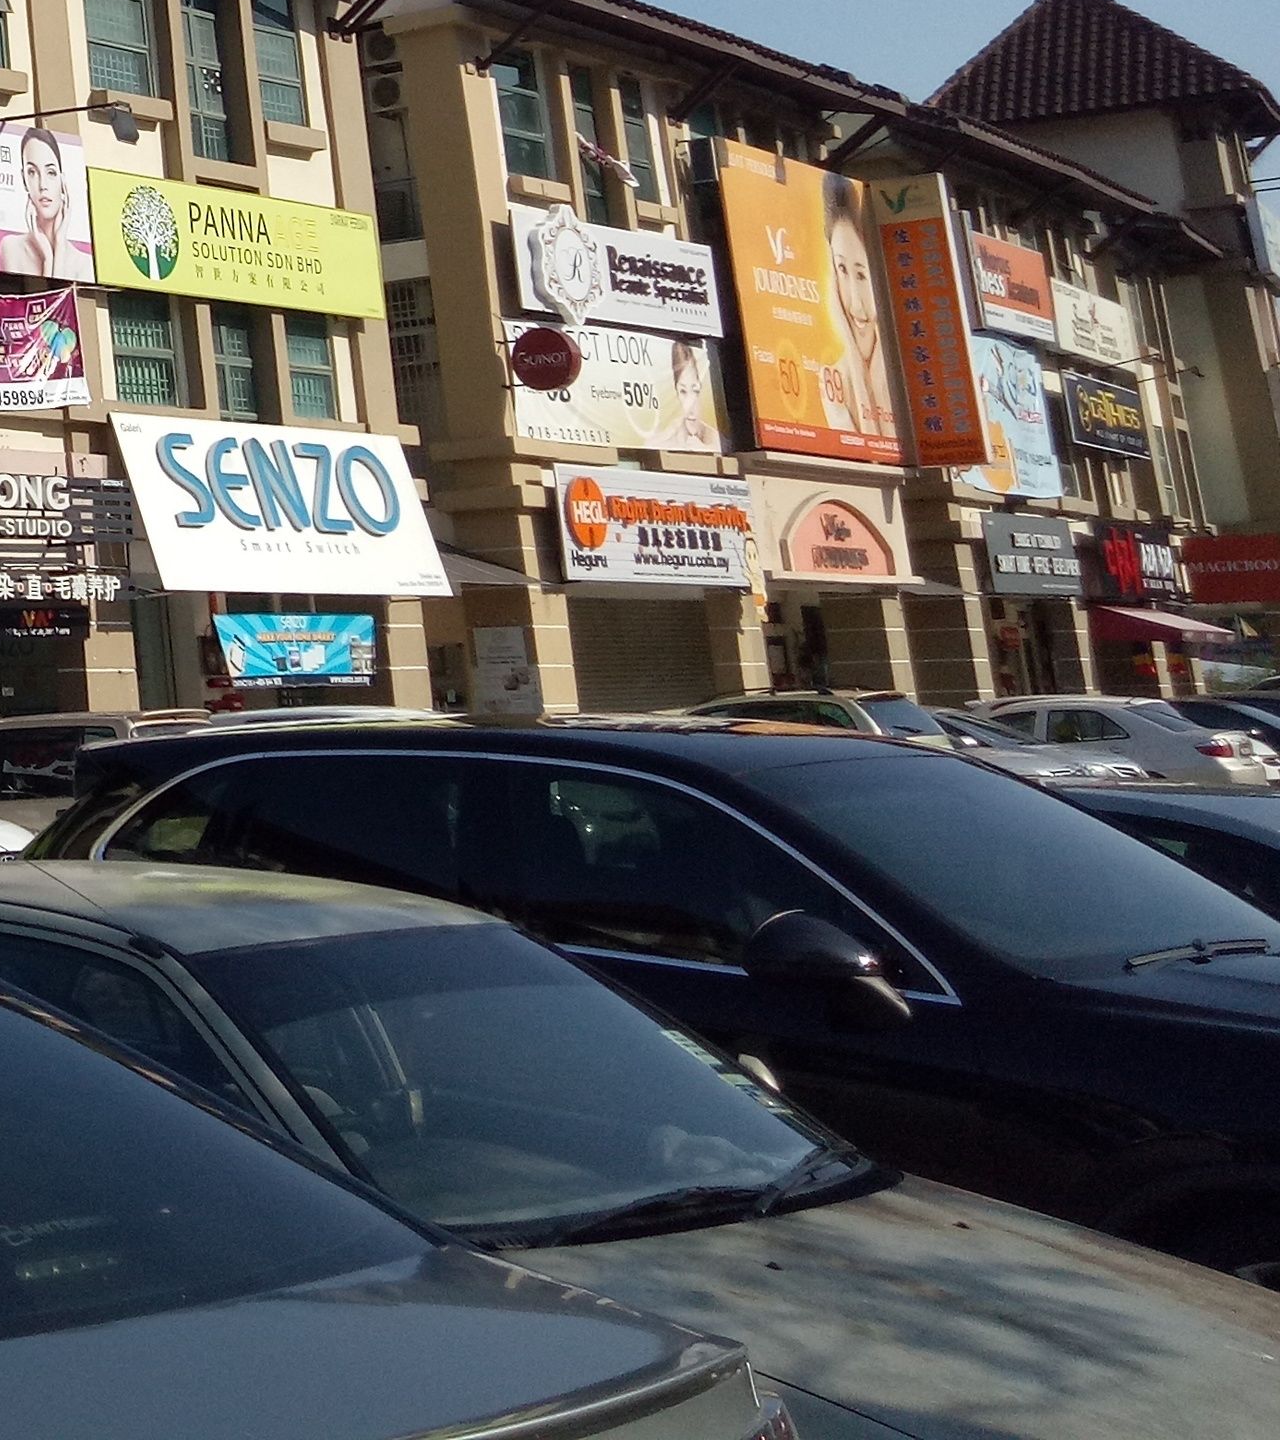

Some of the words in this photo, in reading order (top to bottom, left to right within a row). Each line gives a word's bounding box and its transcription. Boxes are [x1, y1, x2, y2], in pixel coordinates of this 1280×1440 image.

[188, 201, 272, 246] PANNA
[192, 241, 263, 267] SOLUTION
[266, 252, 294, 271] SDN
[297, 256, 323, 275] BHD
[605, 245, 707, 287] Renaissance
[517, 351, 568, 367] GUINOT
[606, 333, 653, 367] LOOK
[622, 381, 659, 409] 50%
[823, 366, 844, 404] 69
[155, 432, 401, 536] SENZO
[3, 515, 73, 538] STUDIO
[239, 538, 293, 554] Smart
[305, 539, 362, 556] Switch
[571, 549, 608, 572] Heguru
